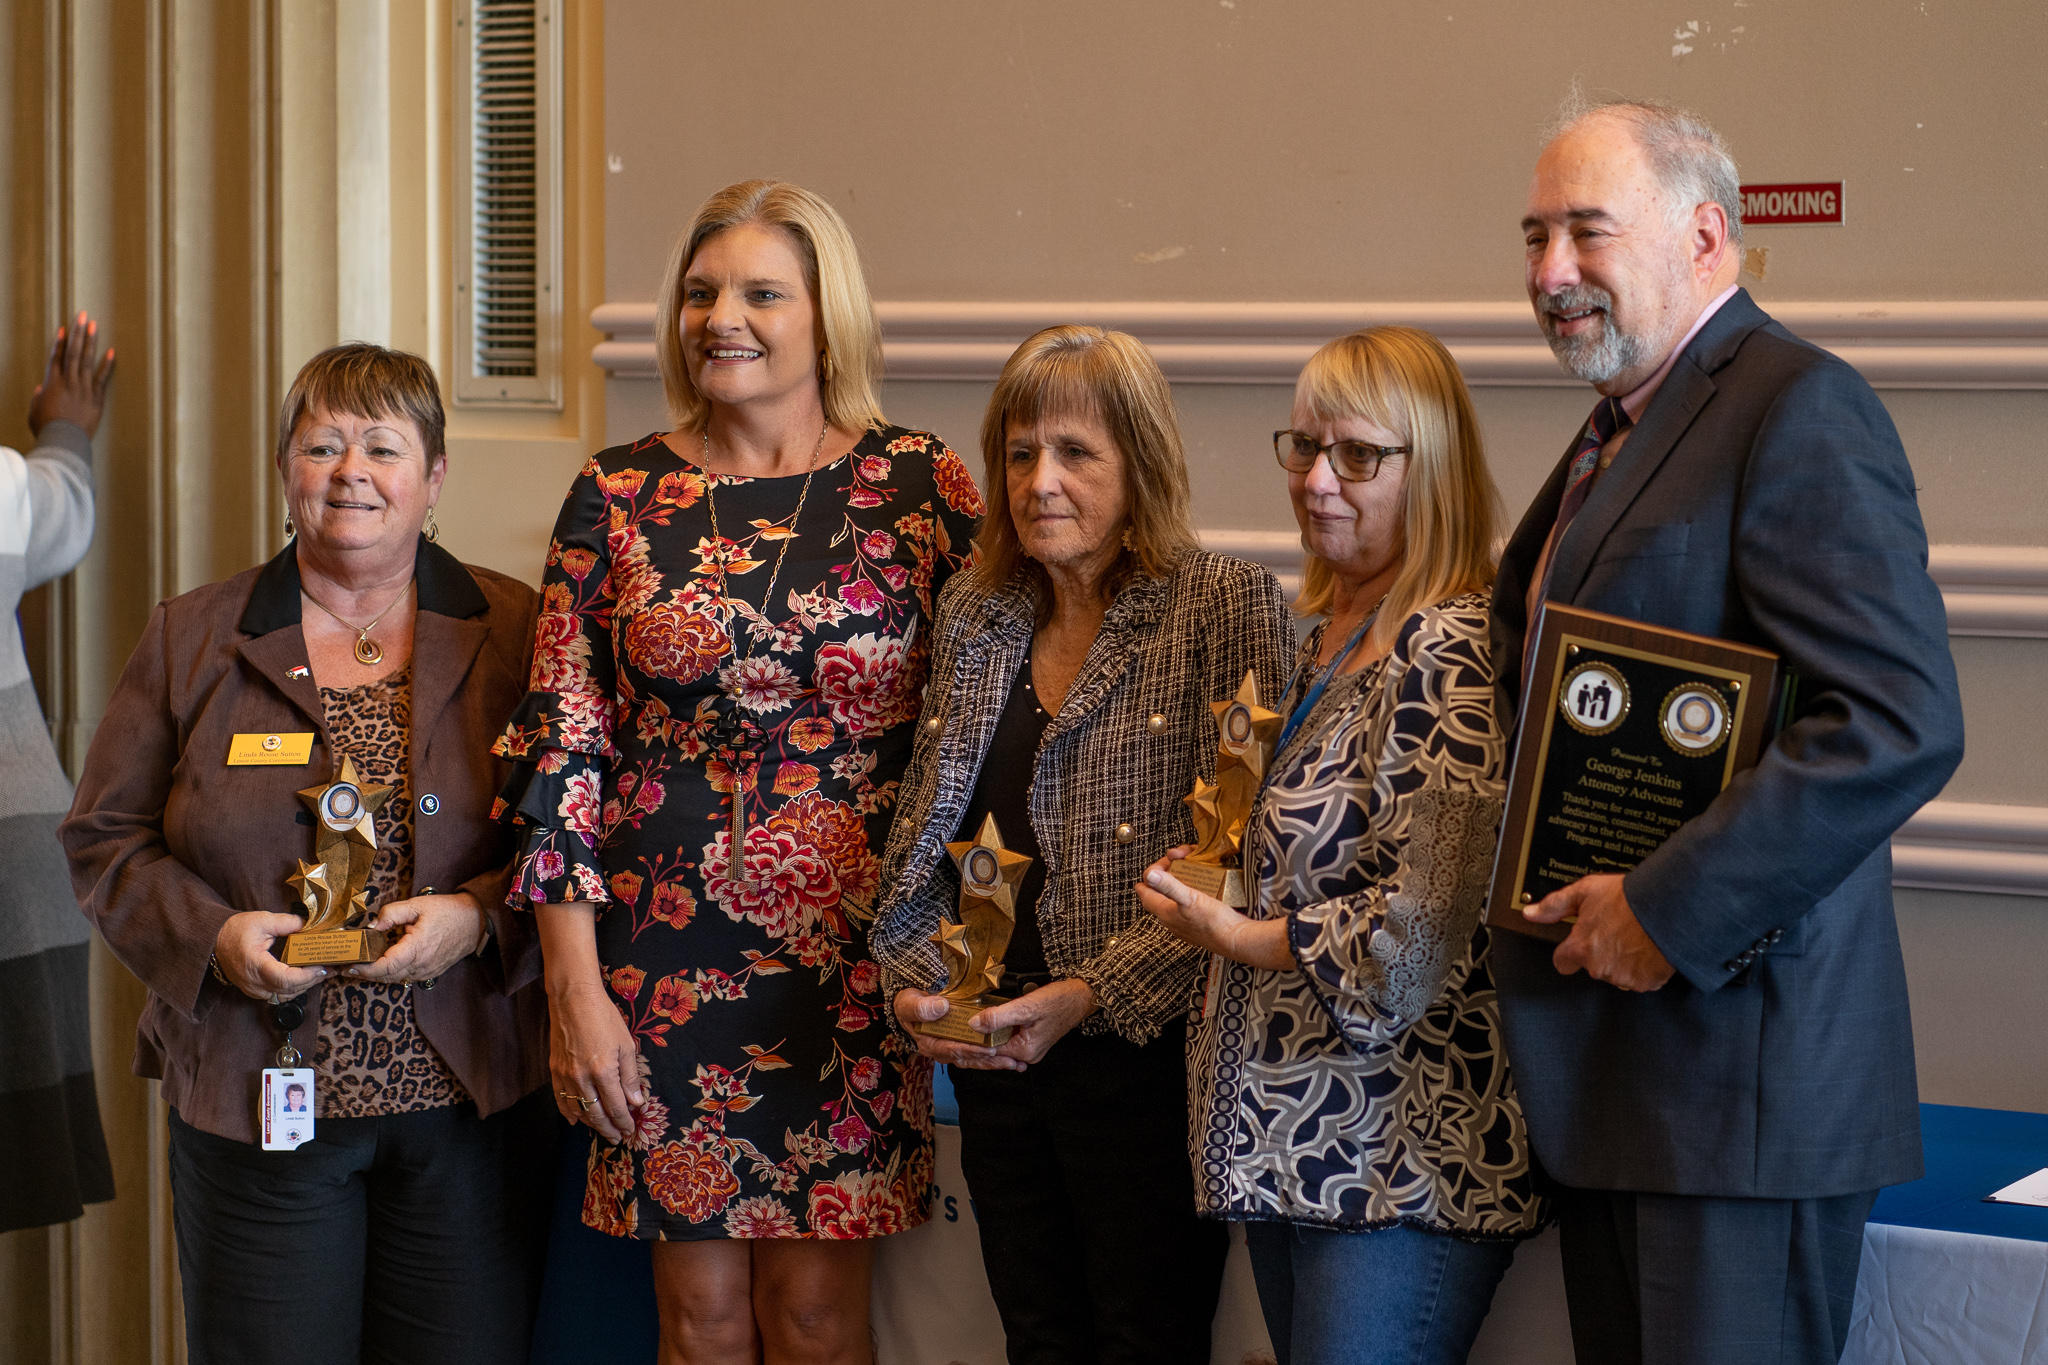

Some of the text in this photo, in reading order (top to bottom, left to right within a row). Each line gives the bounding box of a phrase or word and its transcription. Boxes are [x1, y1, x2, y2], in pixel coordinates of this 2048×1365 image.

[1740, 190, 1836, 217] SMOKING
[1611, 747, 1663, 767] Presented To
[1586, 757, 1682, 790] George Jenkins
[1578, 775, 1684, 808] Attorney Advocate
[1562, 792, 1681, 828] Thank you for over 32 years
[1562, 805, 1668, 838] dedication, commitment,
[1548, 816, 1588, 832] advocacy
[1589, 824, 1598, 833] to
[1600, 826, 1614, 837] the
[1616, 828, 1657, 848] Guardian
[1566, 830, 1603, 846] Program
[1604, 839, 1622, 852] and
[1622, 843, 1634, 856] its
[1538, 866, 1548, 876] in
[1549, 858, 1588, 874] Presented
